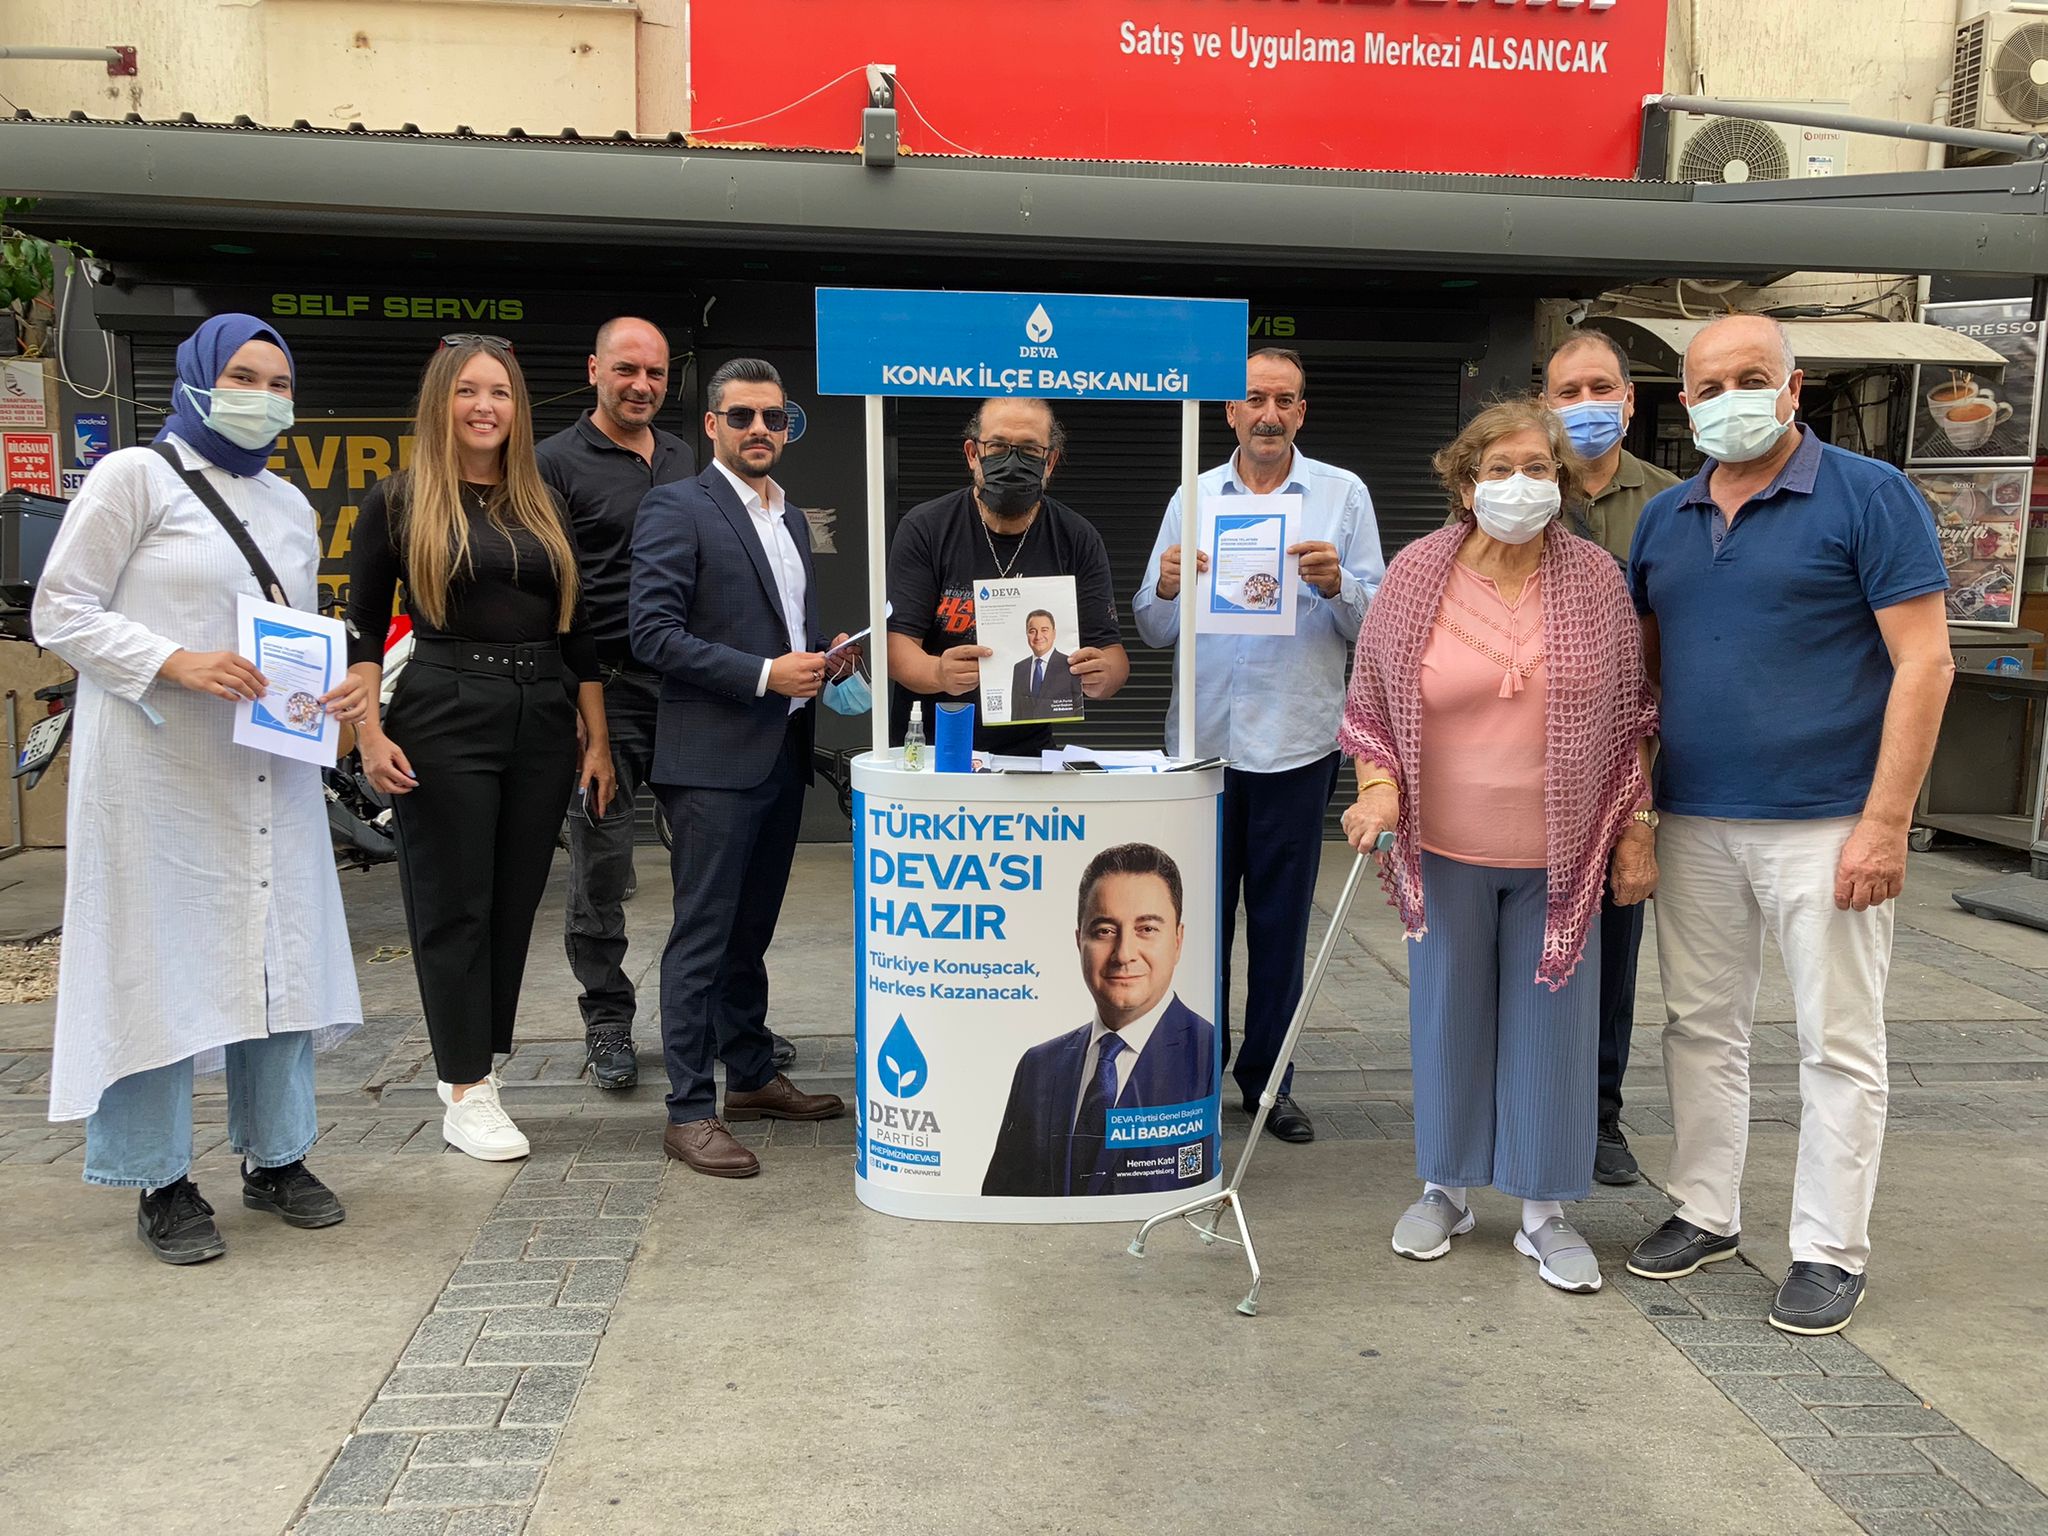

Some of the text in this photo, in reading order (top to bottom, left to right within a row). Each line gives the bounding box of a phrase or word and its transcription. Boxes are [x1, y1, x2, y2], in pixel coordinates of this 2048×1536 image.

[1119, 19, 1609, 73] Satış ve Uygulama Merkezi ALSANCAK
[271, 293, 370, 316] SELF
[1940, 321, 2037, 336] PRESSO
[1019, 346, 1059, 359] DEVA
[882, 362, 1189, 395] KONAK İLÇE BAŞKANLIĞI
[991, 587, 1021, 597] DEVA
[869, 803, 1085, 841] TÜRKİYE'NİN
[869, 848, 1042, 891] DEVA'SI
[870, 896, 1006, 940] HAZIR
[869, 950, 1040, 979] Türkiye Konuşacak,
[869, 974, 1039, 1000] Herkes Kazanacak.
[869, 1100, 941, 1133] DEVA
[1111, 1115, 1134, 1124] DEVA
[1134, 1113, 1159, 1122] Partisi
[1159, 1111, 1181, 1121] Genel
[877, 1128, 929, 1148] PARTİSİ
[1110, 1119, 1203, 1141] ALİ BABACAN
[1127, 1156, 1175, 1168] Hemen Katıl
